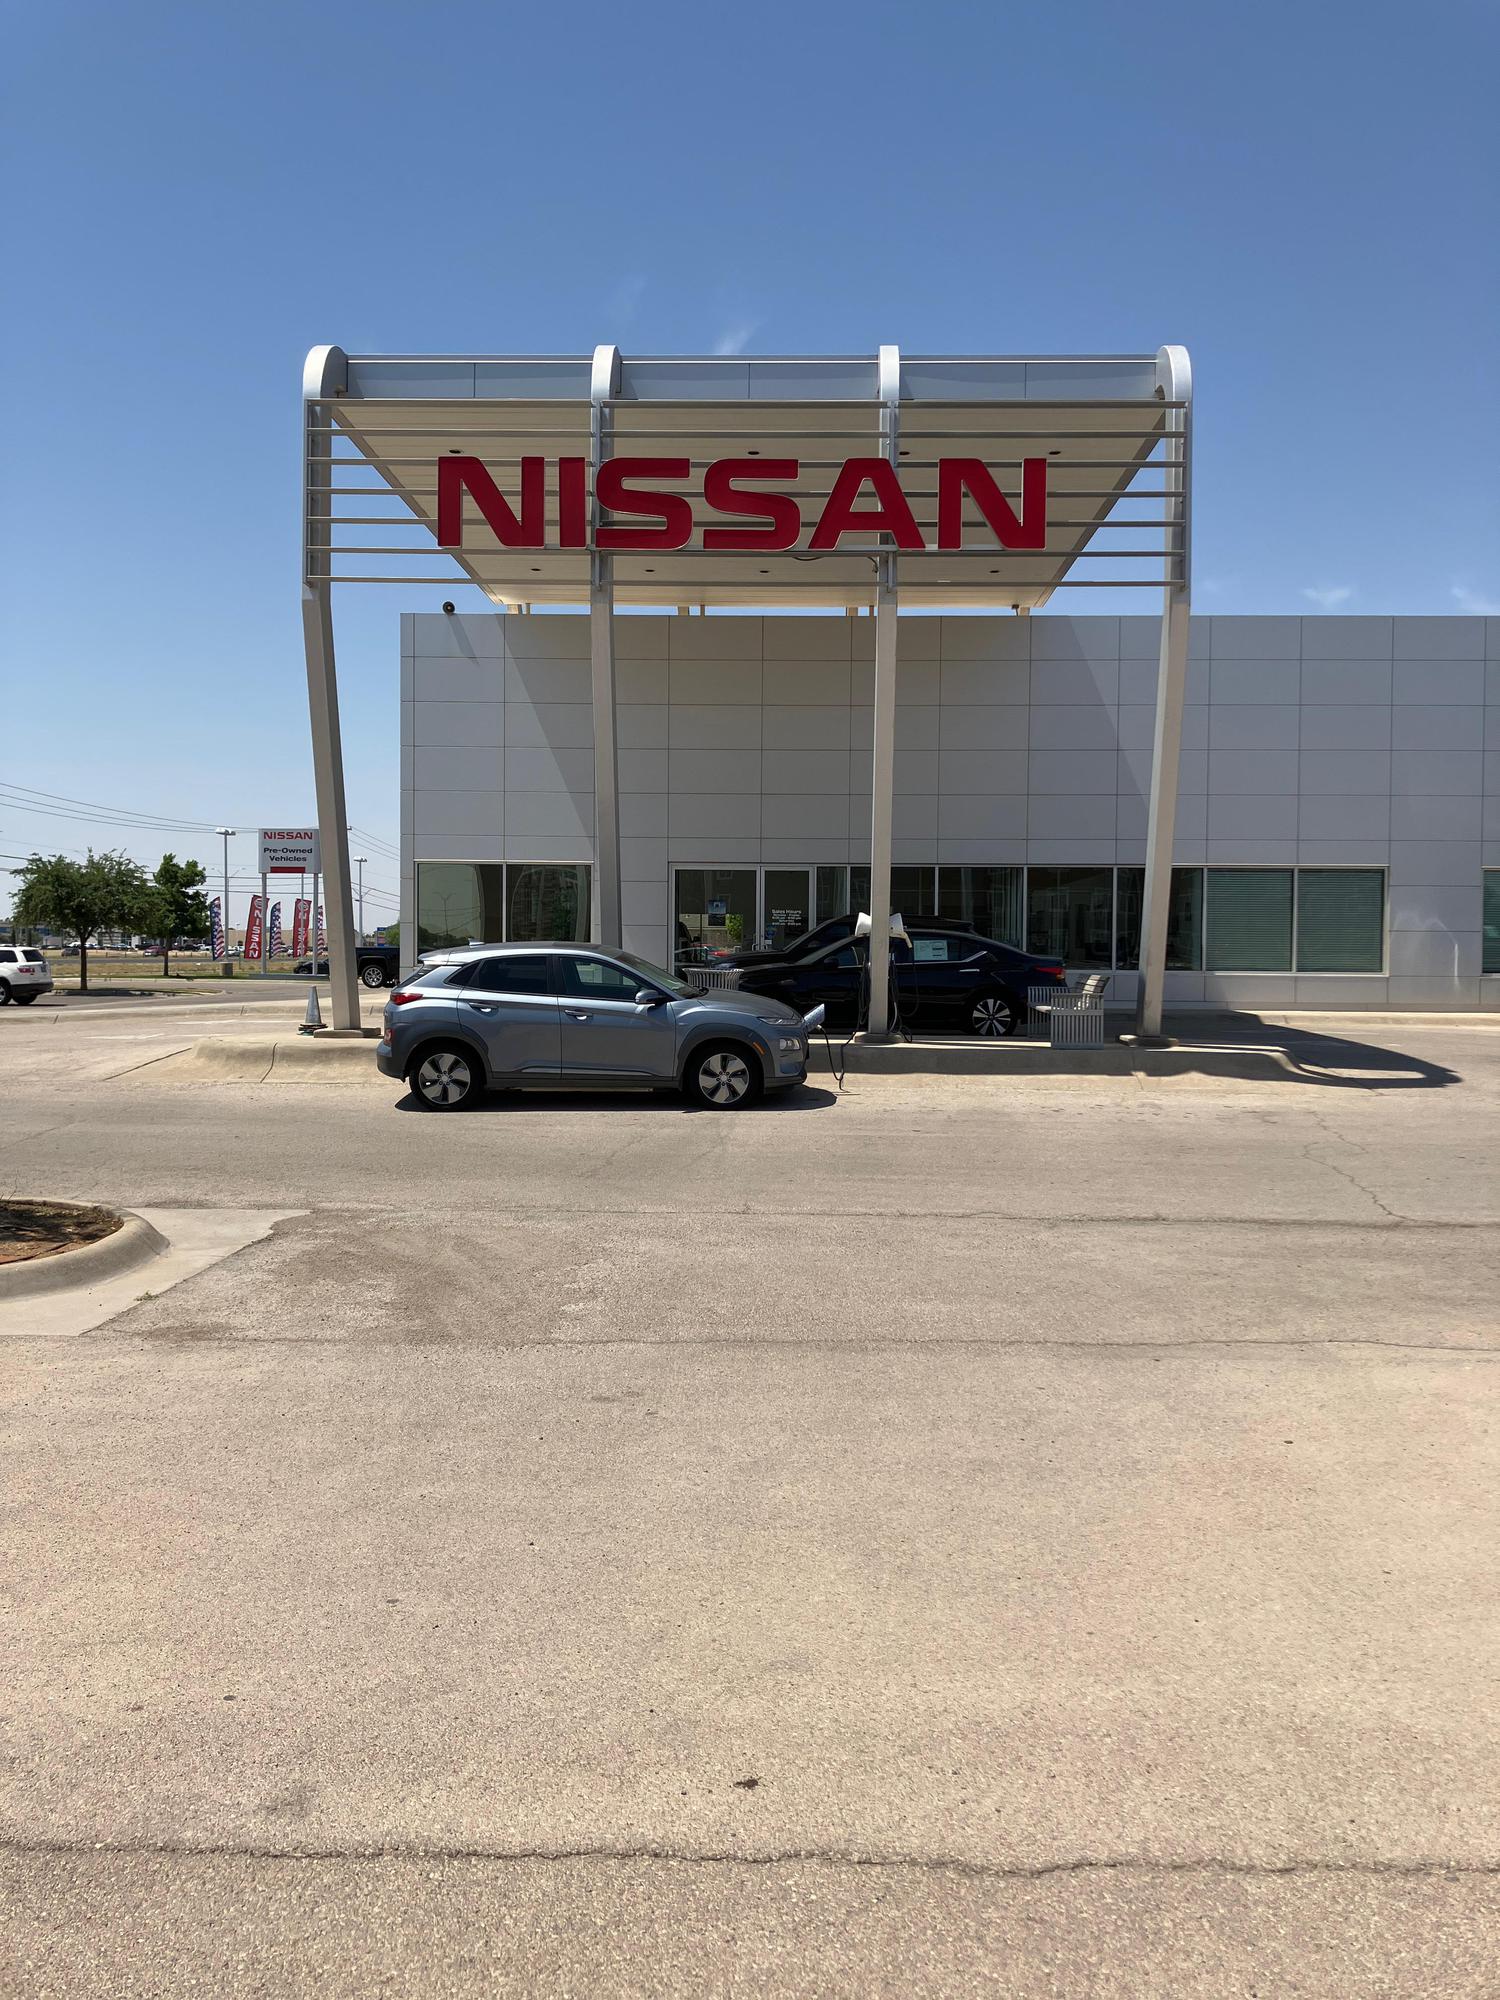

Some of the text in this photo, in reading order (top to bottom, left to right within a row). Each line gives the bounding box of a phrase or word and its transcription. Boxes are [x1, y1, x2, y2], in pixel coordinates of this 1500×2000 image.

[438, 456, 1047, 550] NISSAN
[263, 831, 313, 840] NISSAN
[249, 909, 263, 958] NISSAN
